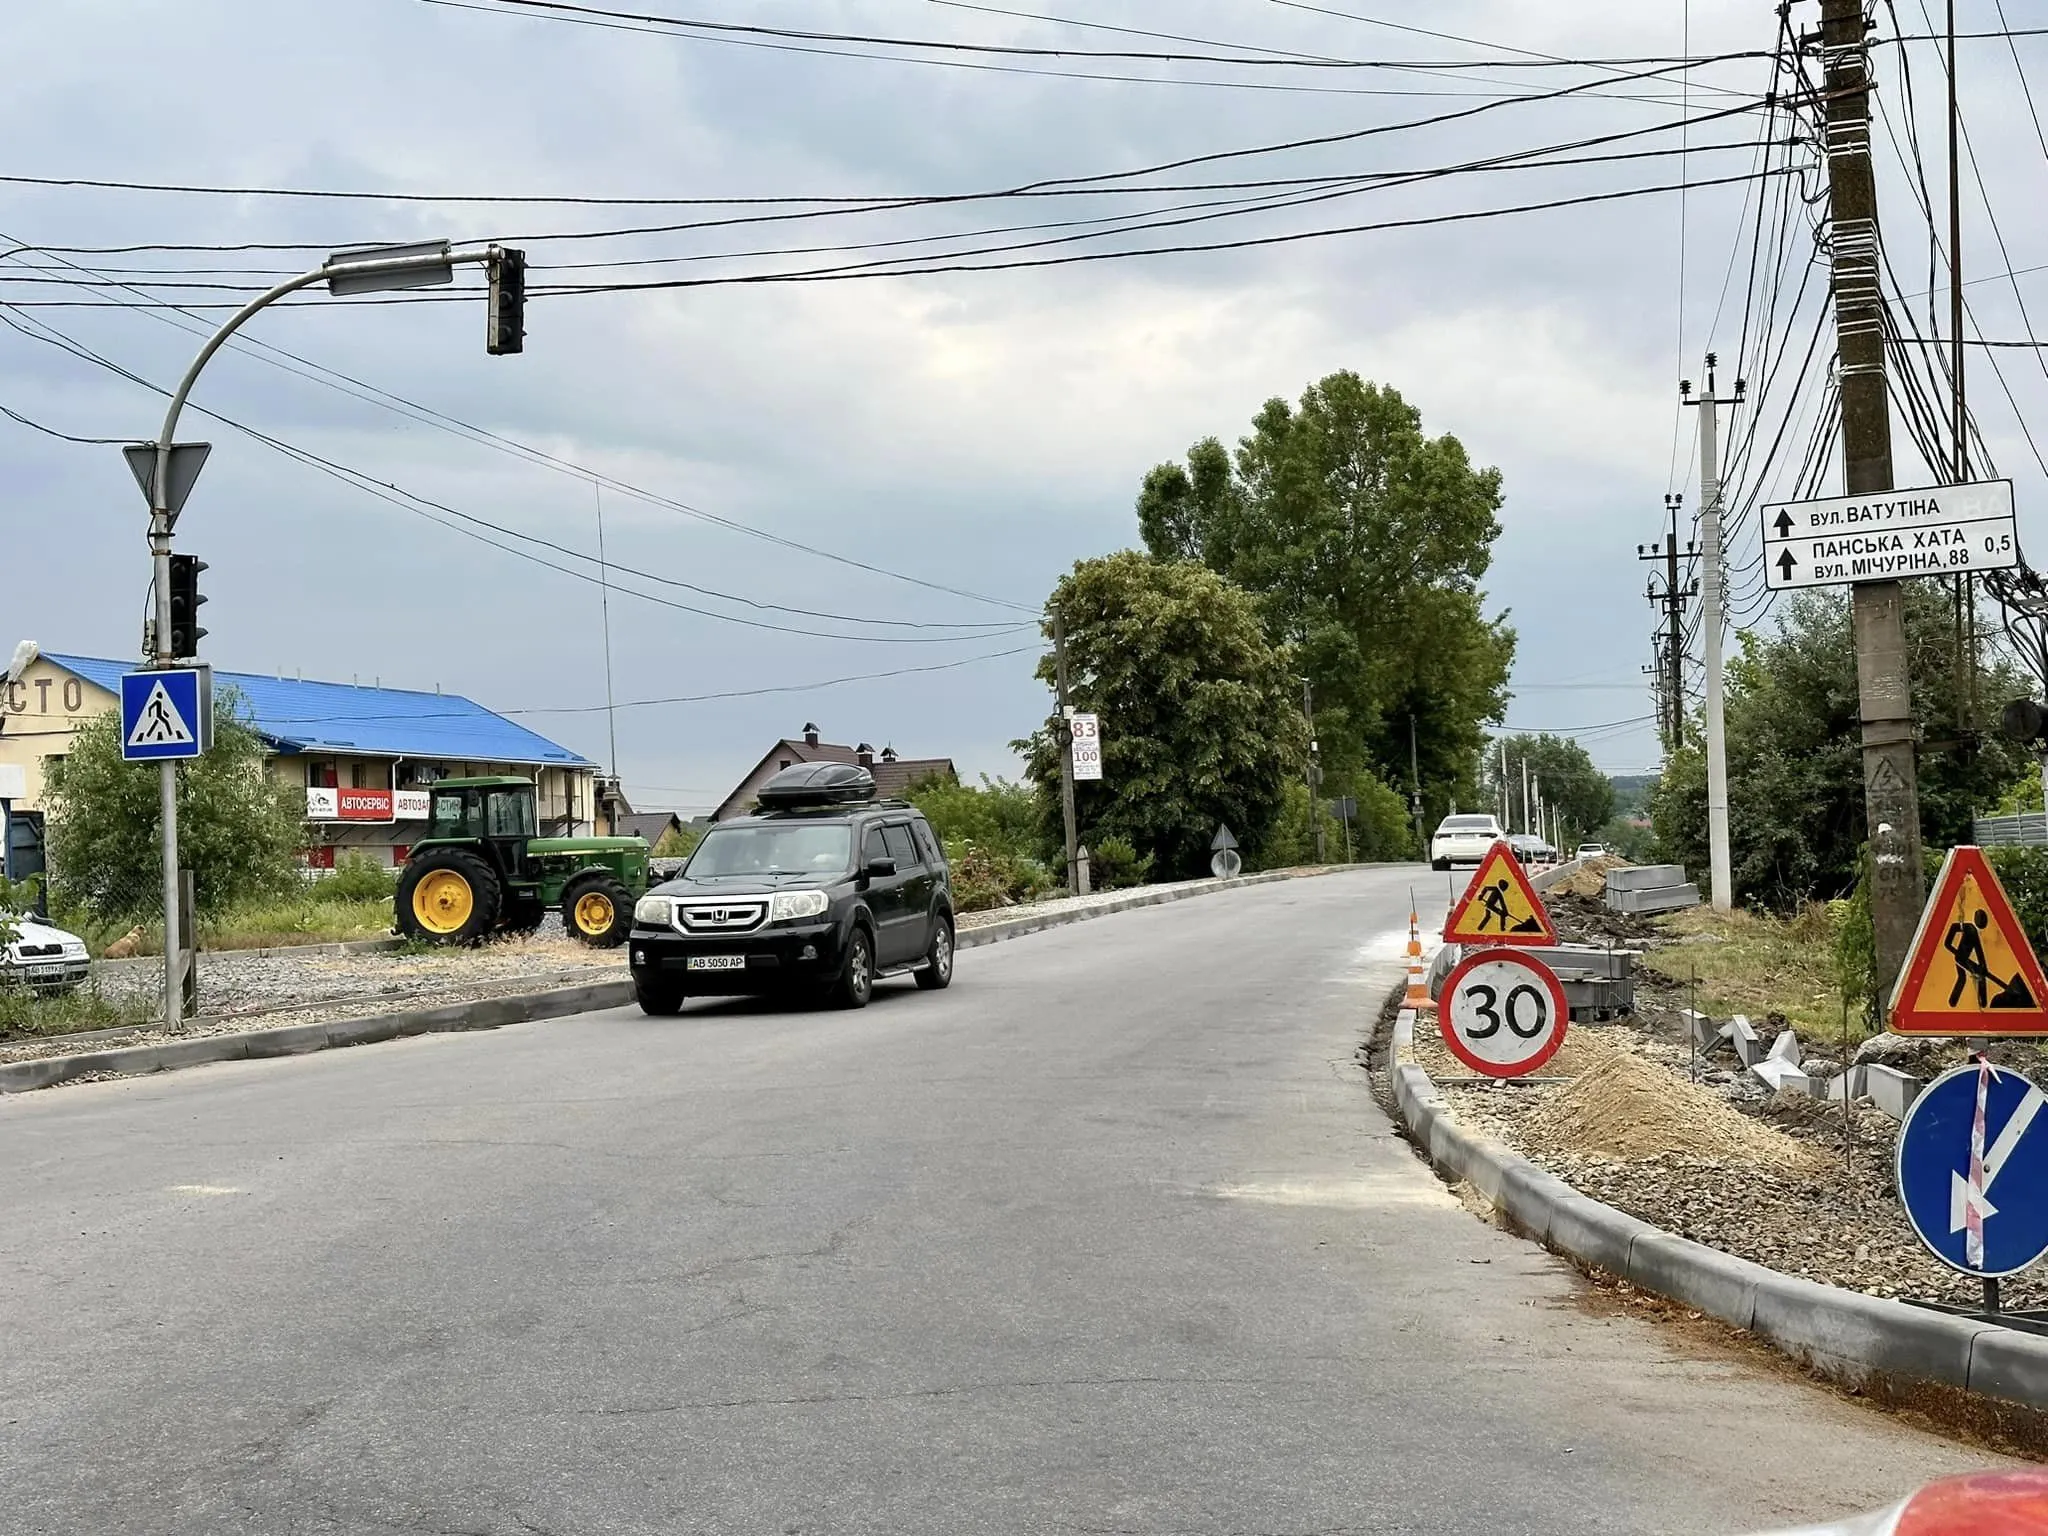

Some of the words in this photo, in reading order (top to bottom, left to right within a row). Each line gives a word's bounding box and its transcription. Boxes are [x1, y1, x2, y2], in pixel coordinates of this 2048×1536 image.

[1810, 511, 1844, 526] ВУЛ.
[1847, 498, 1940, 522] ВАТУТІНА
[1813, 535, 1903, 559] ПАНСЬКА
[1913, 528, 1966, 549] ХАТА
[1984, 535, 2010, 555] 0,5
[1815, 564, 1848, 579] ВУЛ.
[8, 678, 82, 713] СТО
[1073, 722, 1096, 737] 83
[341, 797, 390, 810] АВТОСЕРВІС
[708, 958, 728, 968] 5050
[1465, 984, 1546, 1038] 30
